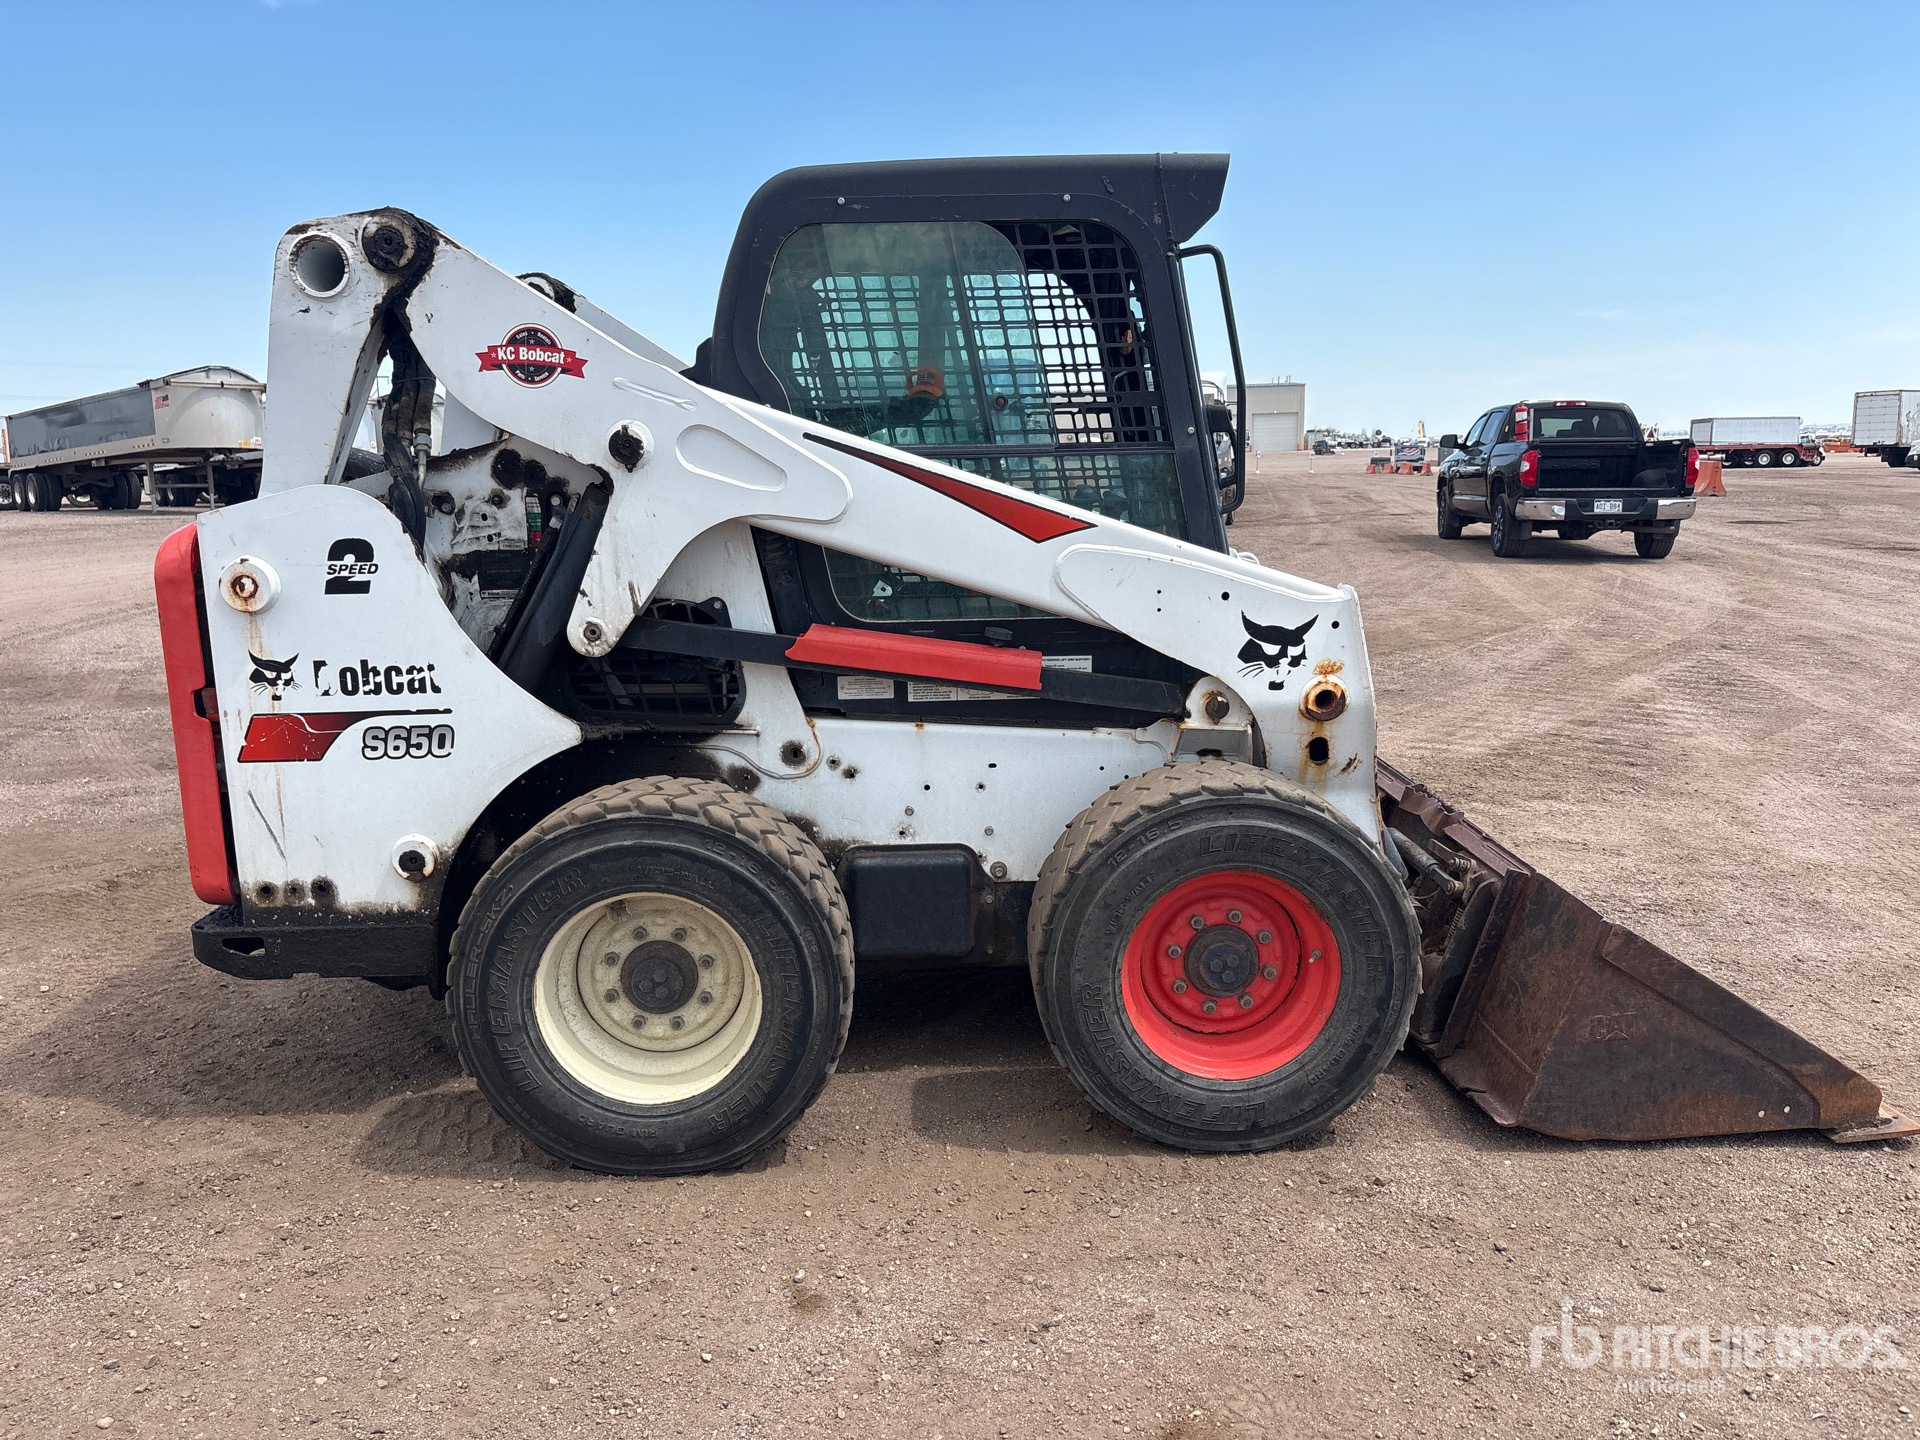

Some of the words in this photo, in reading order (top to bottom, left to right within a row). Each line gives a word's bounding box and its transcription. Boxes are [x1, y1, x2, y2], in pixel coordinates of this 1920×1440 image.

[497, 347, 515, 360] KC
[519, 347, 566, 364] Bobcat
[516, 331, 528, 340] Sales
[324, 538, 375, 595] 2
[326, 562, 379, 576] SPEED
[361, 725, 455, 760] S650
[1200, 833, 1385, 978] LIFEMASTER
[488, 867, 587, 1093] LIFEMASTER
[709, 914, 804, 1135] LIFEMASTER
[1082, 982, 1268, 1127] LIFEMASTER
